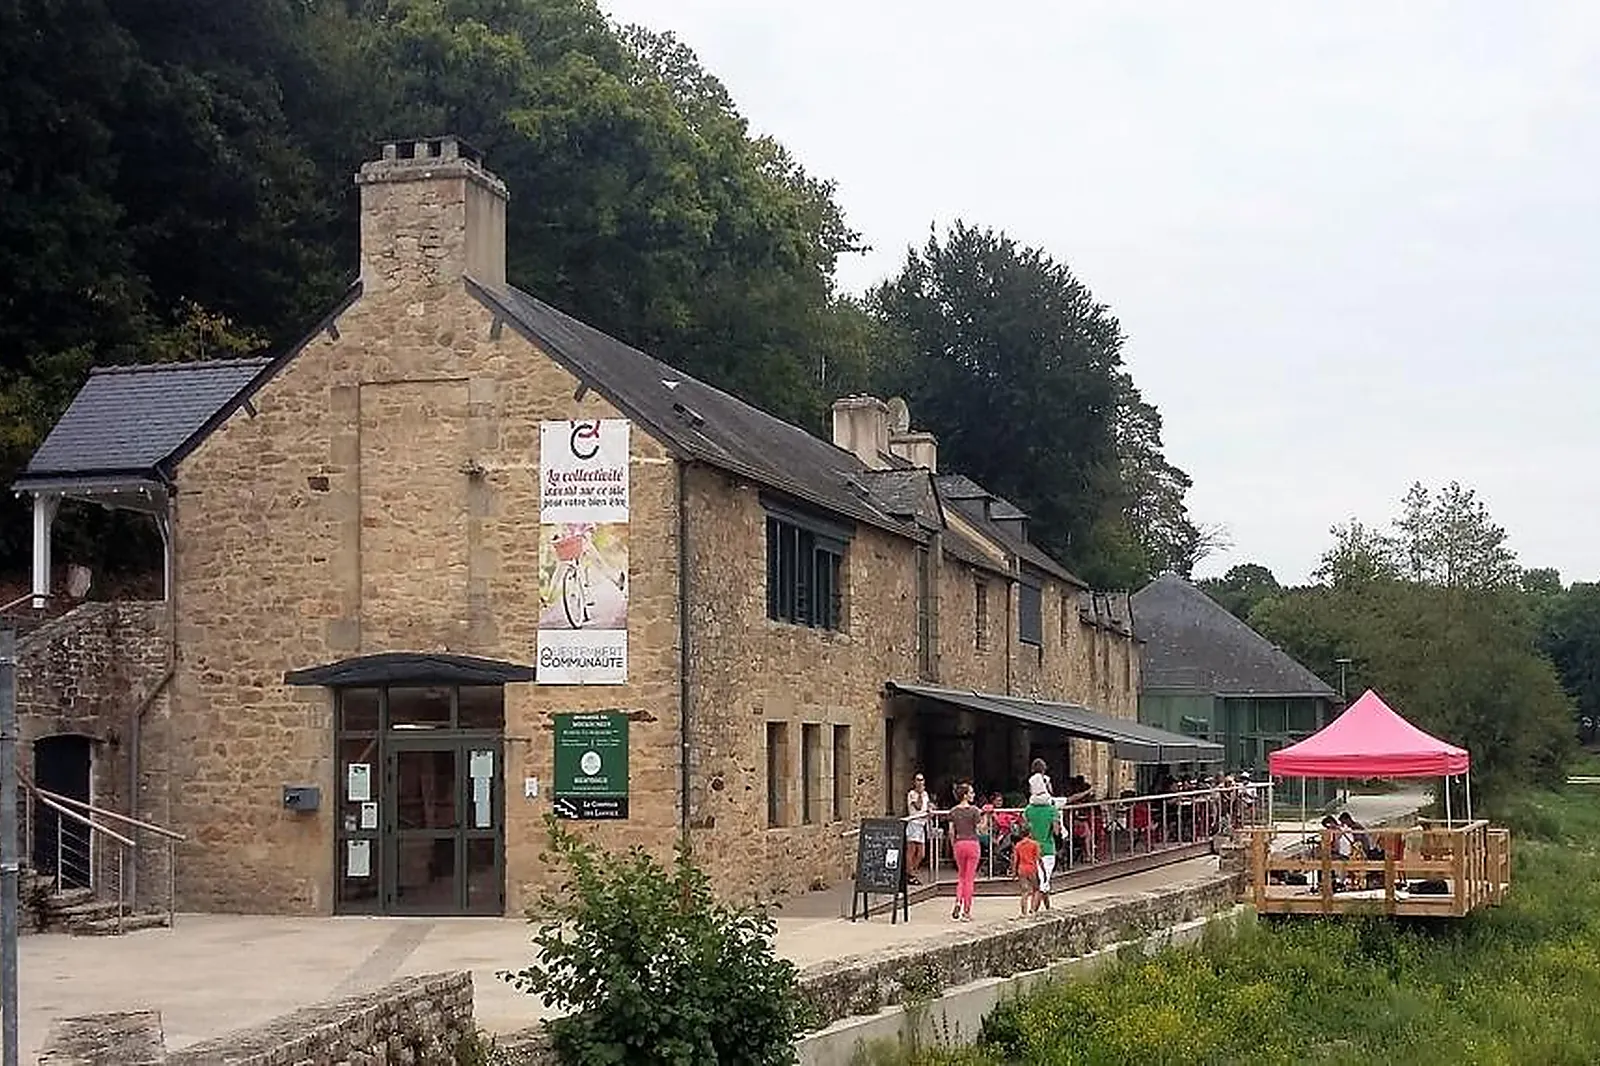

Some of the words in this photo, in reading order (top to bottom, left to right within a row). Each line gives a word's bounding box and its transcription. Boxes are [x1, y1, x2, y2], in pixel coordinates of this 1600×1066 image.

[546, 469, 560, 487] La
[562, 467, 624, 482] collectivité
[542, 499, 562, 509] pour
[564, 498, 586, 507] votre
[588, 498, 607, 507] bien
[609, 497, 626, 508] être
